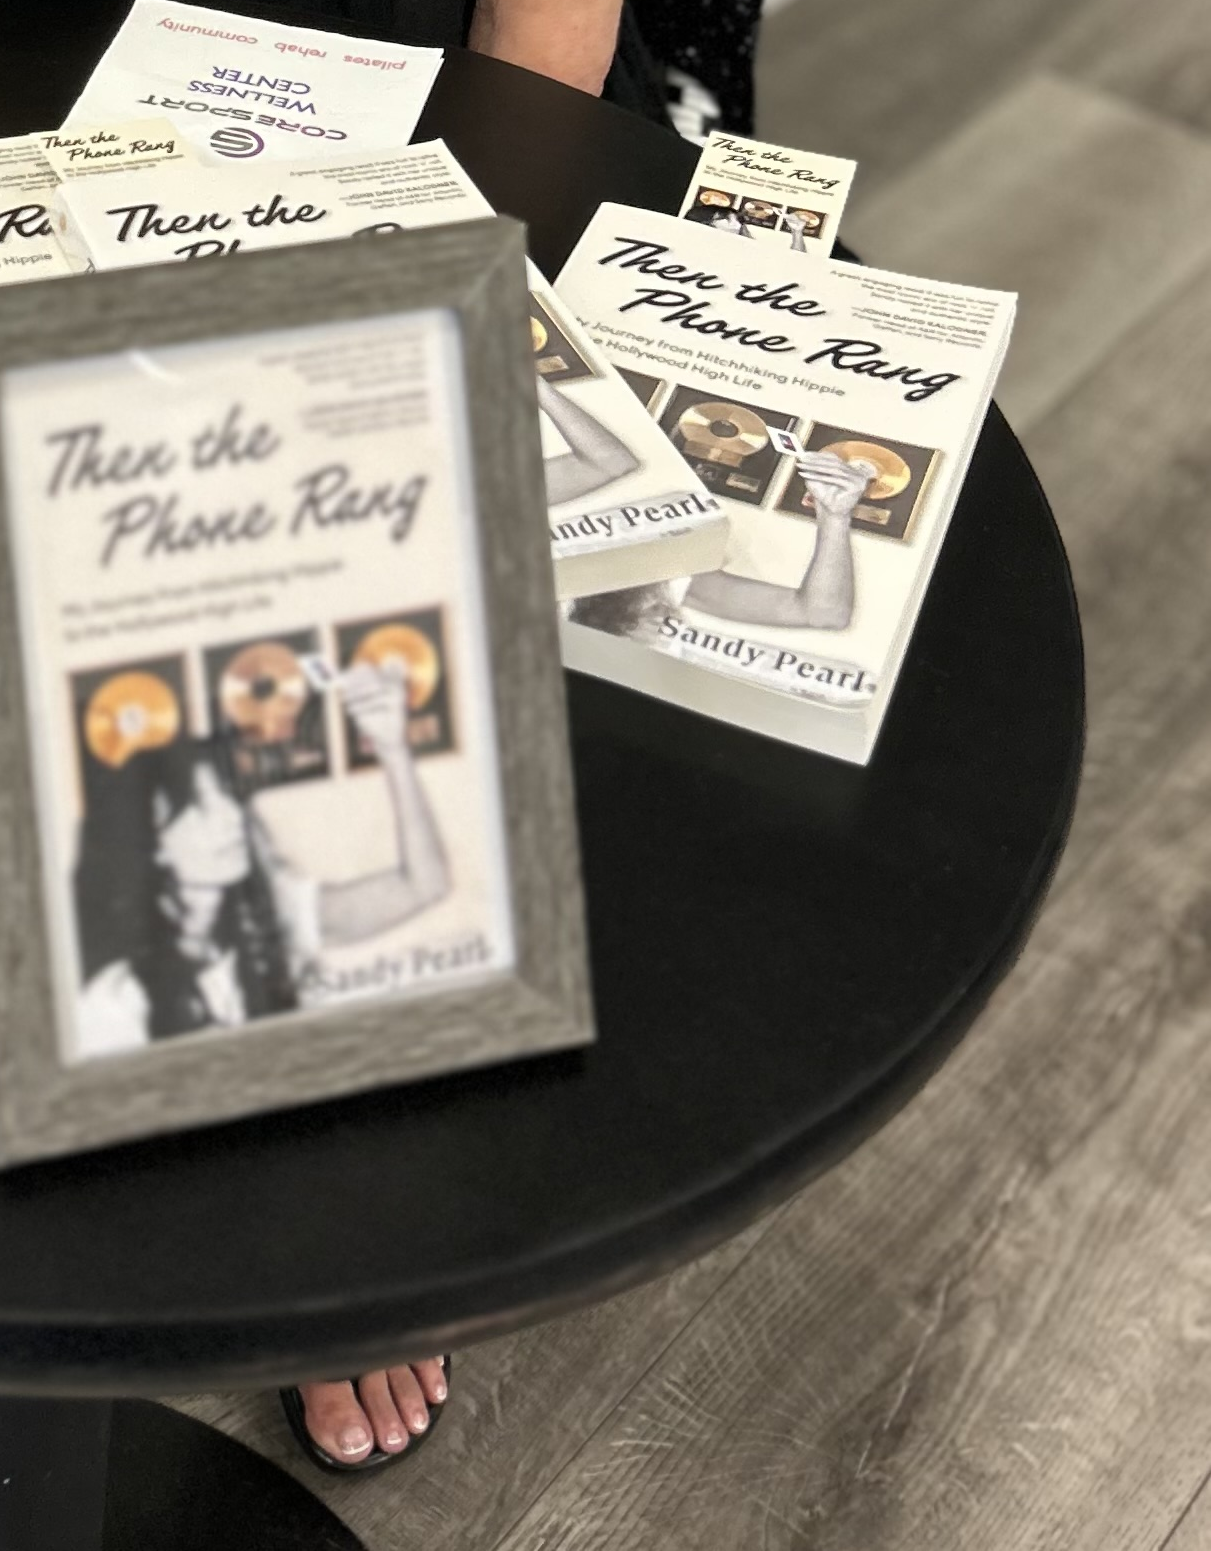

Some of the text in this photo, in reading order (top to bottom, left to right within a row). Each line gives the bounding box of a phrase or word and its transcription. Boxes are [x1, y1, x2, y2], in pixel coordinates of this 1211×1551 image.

[156, 17, 407, 70] pilates rehab community
[187, 80, 317, 115] WELLNESS
[212, 66, 311, 95] CENTER
[41, 131, 120, 149] Then the
[68, 140, 175, 161] Phone Rang
[712, 137, 793, 163] Then the
[722, 155, 784, 175] Phone
[787, 169, 841, 189] Rang
[106, 203, 232, 242] Then
[242, 194, 326, 227] the
[3, 252, 53, 267] Hippie
[597, 236, 726, 290] Then
[734, 283, 827, 318] the
[592, 322, 654, 347] Journey
[657, 340, 694, 356] from
[696, 350, 789, 384] Hitchhiking
[791, 375, 846, 397] Hippie
[605, 340, 763, 390] Hollywood High Life
[618, 287, 797, 354] Phone
[804, 337, 961, 403] Rang
[45, 402, 281, 498] Then the
[98, 462, 429, 569] Phone Rang
[658, 615, 765, 666] Sandy
